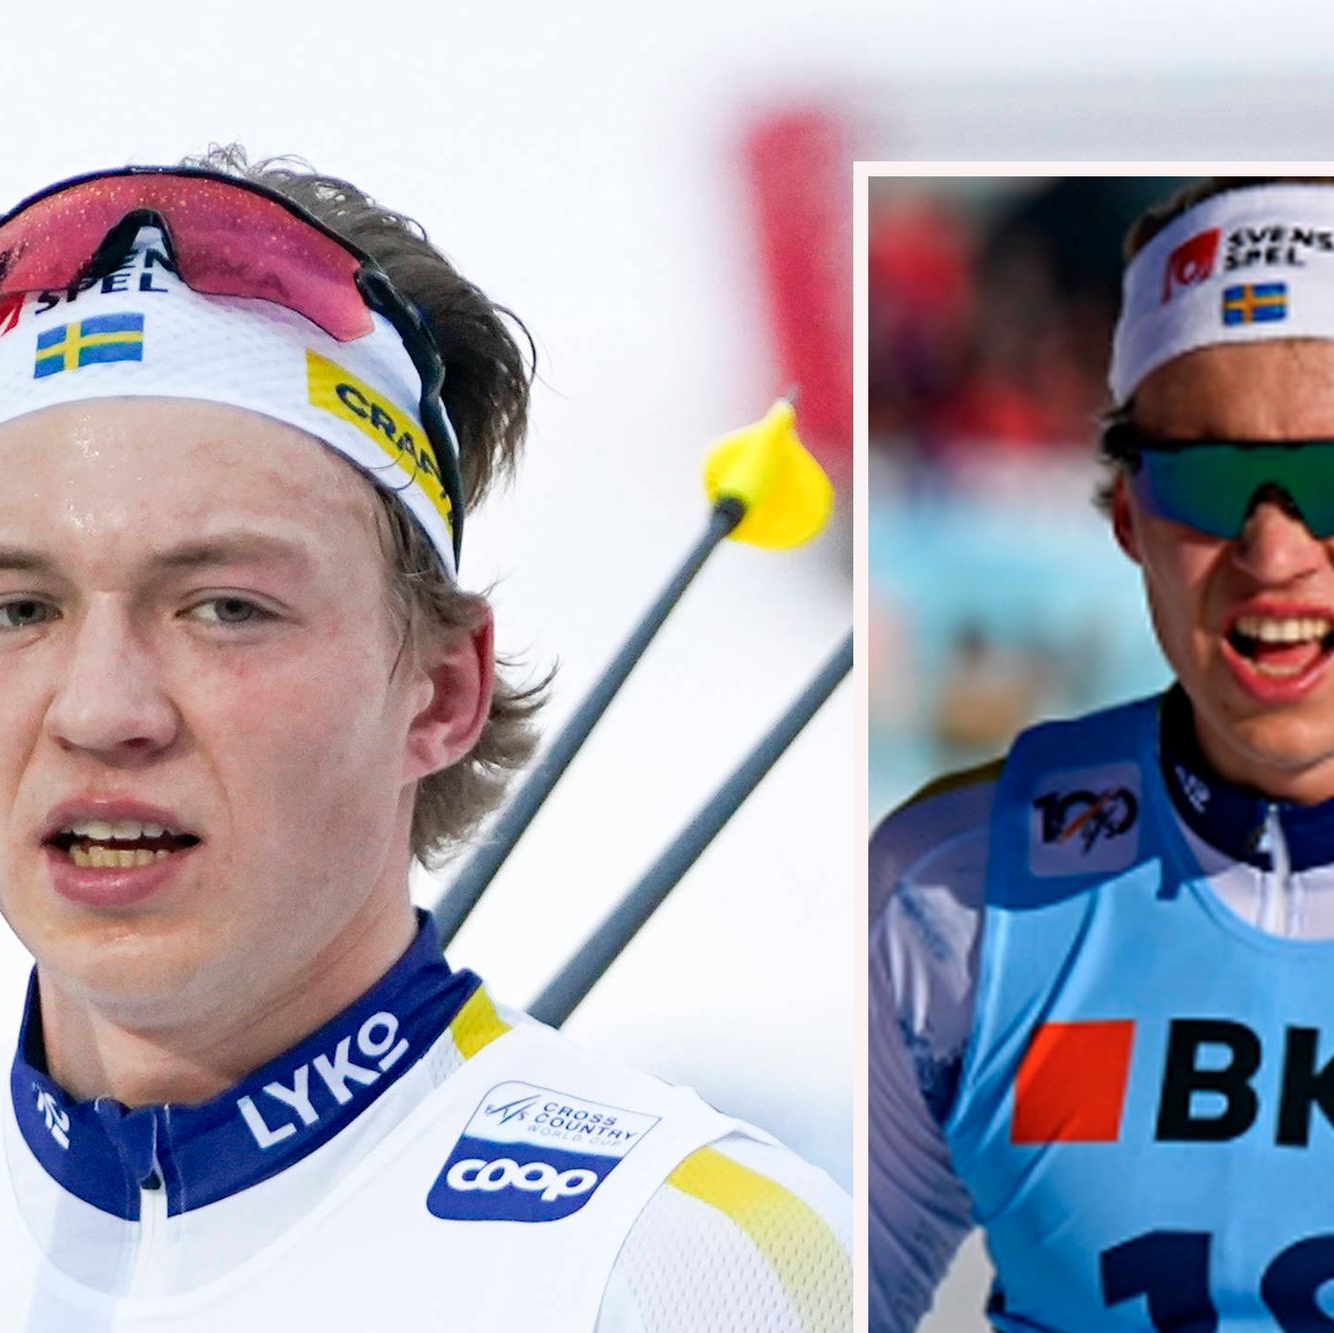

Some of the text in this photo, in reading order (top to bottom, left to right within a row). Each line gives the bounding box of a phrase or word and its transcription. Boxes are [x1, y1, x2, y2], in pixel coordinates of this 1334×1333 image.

[1223, 247, 1305, 272] SPEL
[335, 383, 449, 499] CRAF
[236, 1010, 411, 1150] LYKO
[533, 1113, 638, 1141] COUNTRY
[542, 1102, 618, 1127] CROSS
[526, 1124, 624, 1149] WORLD CUP
[446, 1157, 599, 1202] coop
